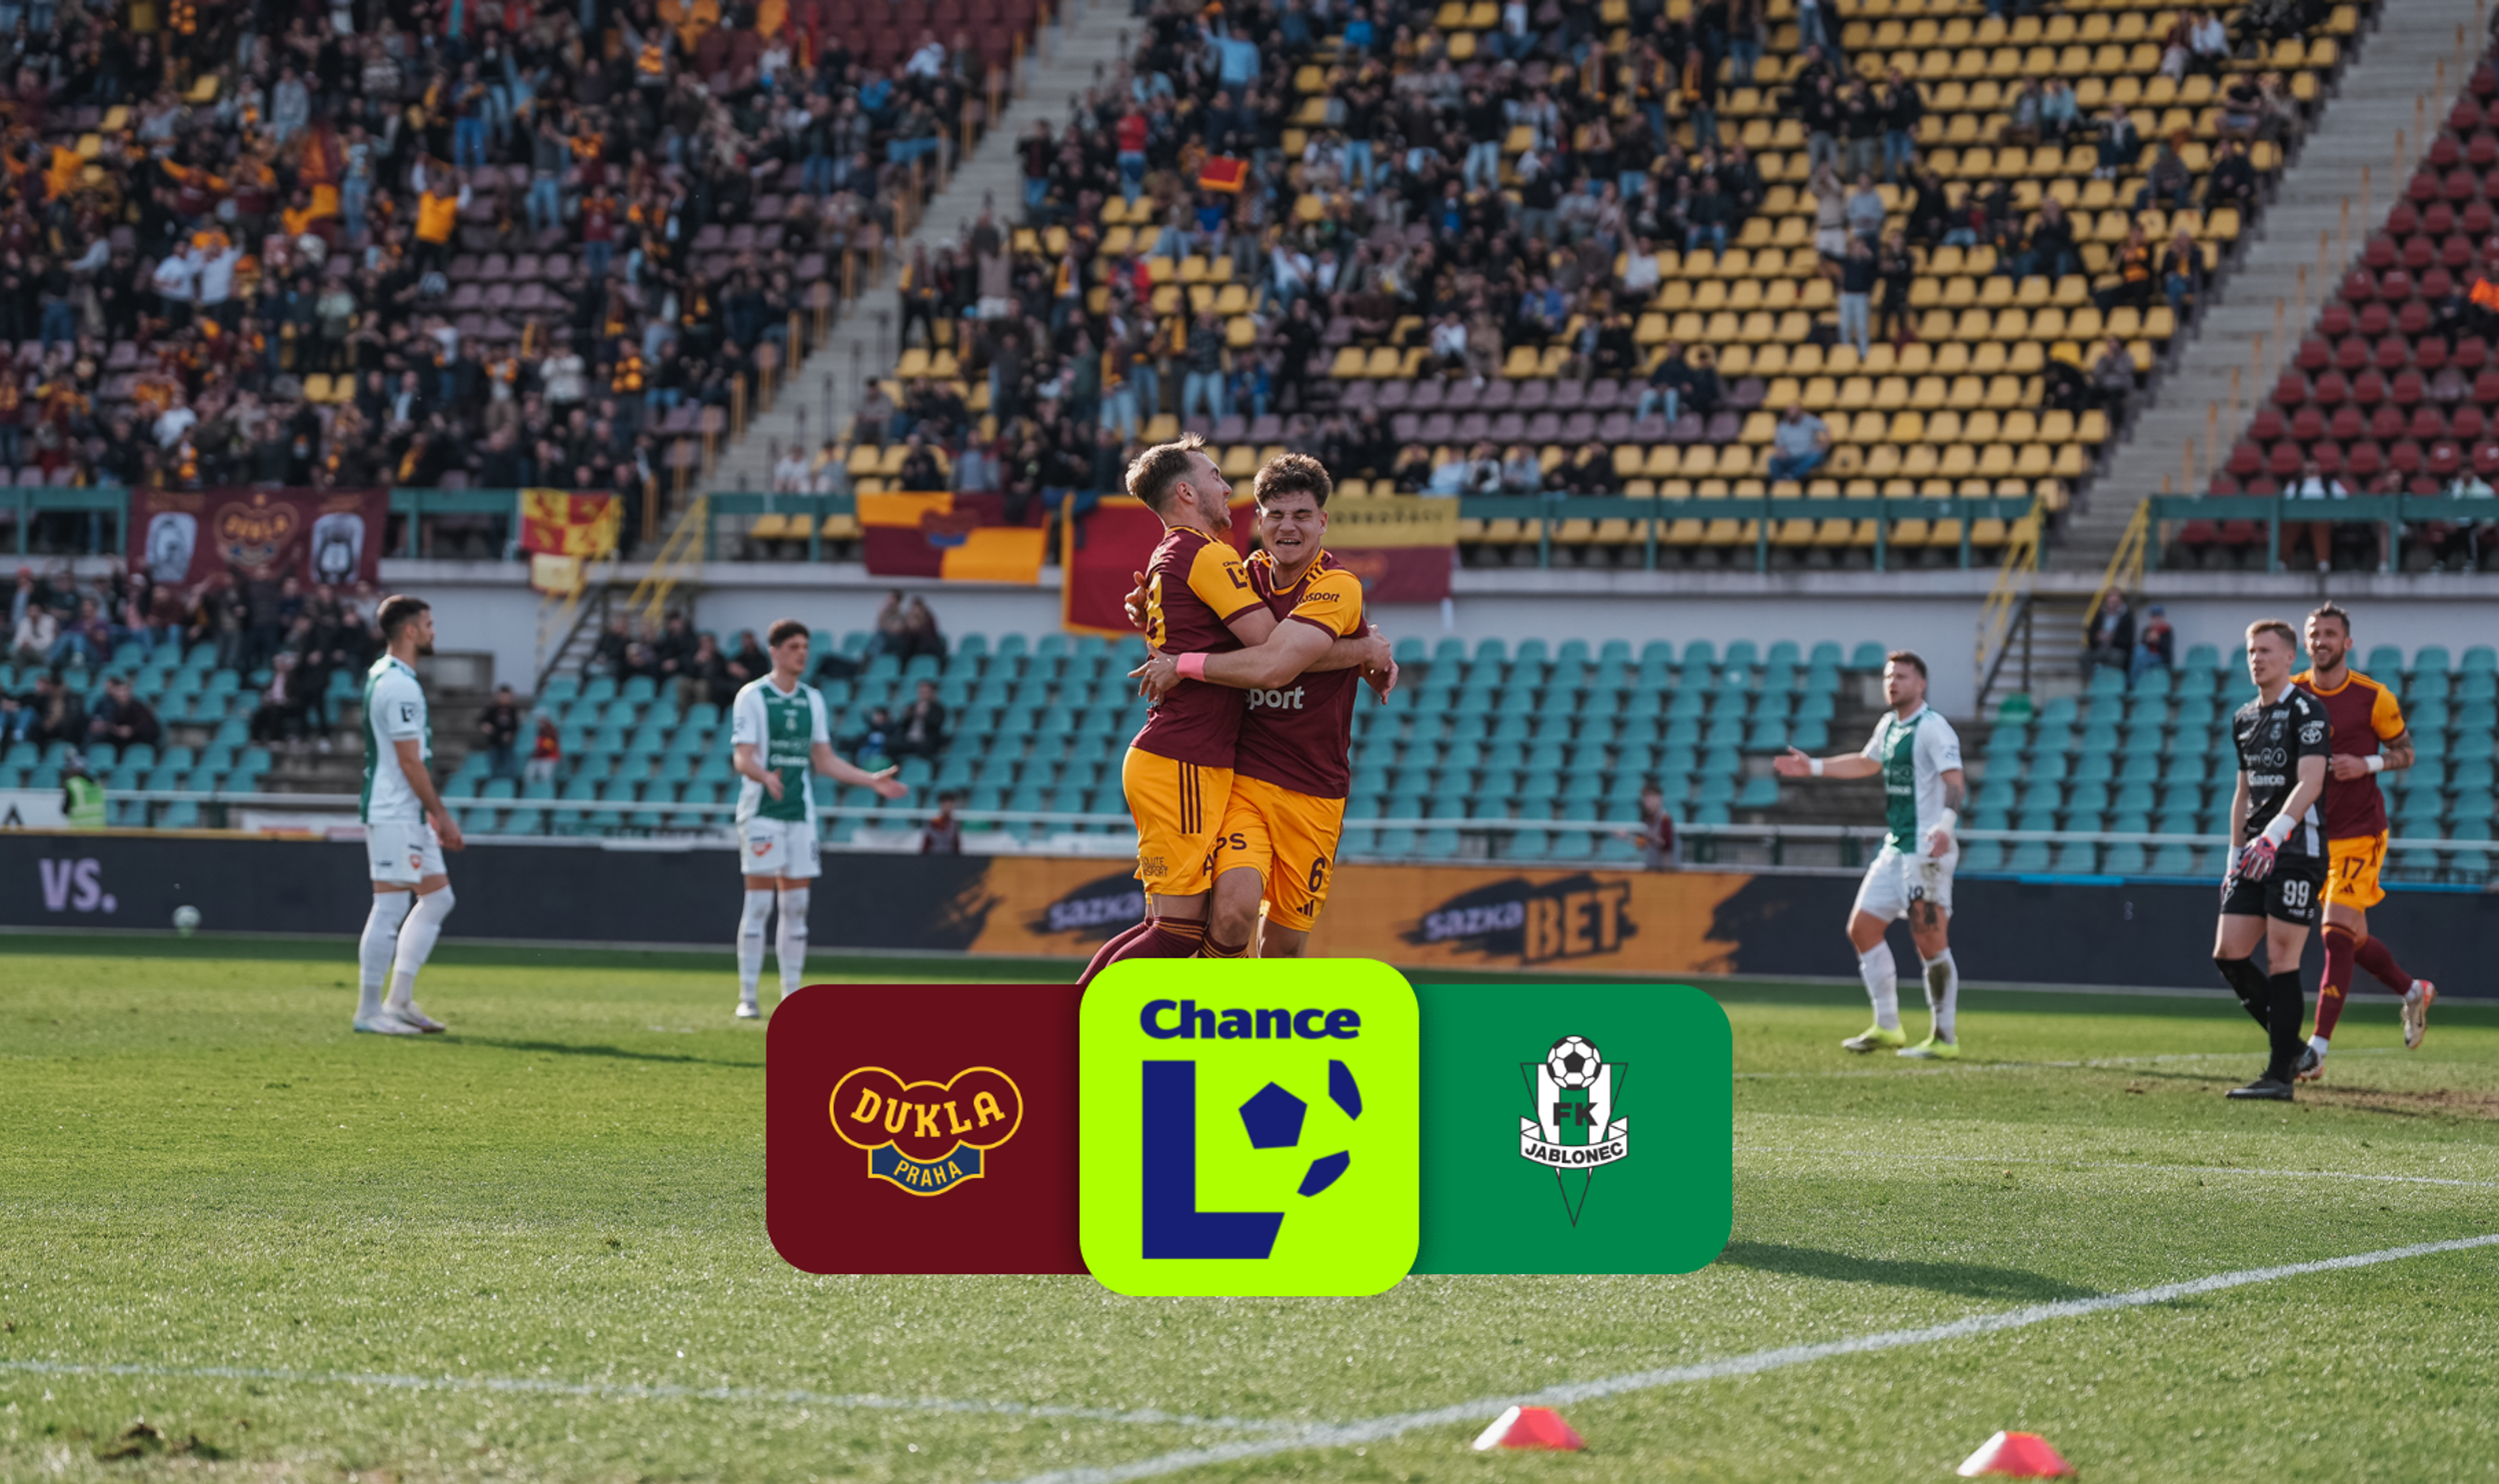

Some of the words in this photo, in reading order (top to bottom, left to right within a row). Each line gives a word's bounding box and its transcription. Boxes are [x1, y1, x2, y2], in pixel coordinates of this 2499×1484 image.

[1308, 857, 1325, 892] 6
[2342, 855, 2365, 879] 17
[38, 857, 118, 914] VS.
[2282, 879, 2310, 907] 99
